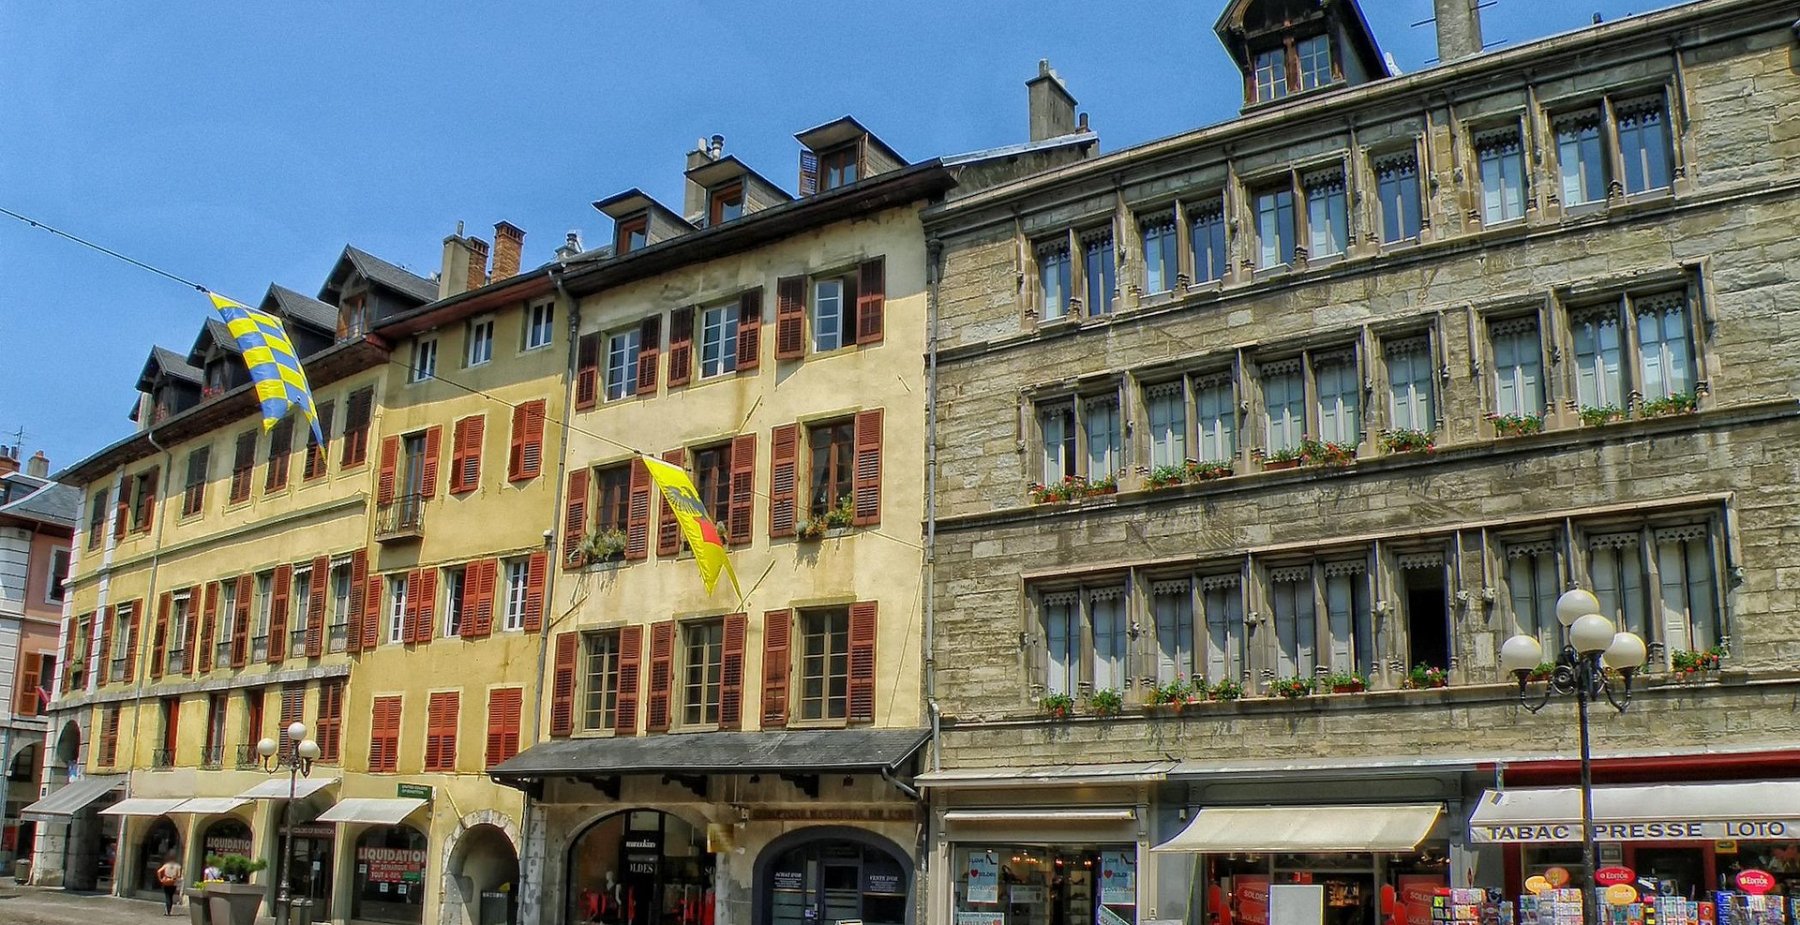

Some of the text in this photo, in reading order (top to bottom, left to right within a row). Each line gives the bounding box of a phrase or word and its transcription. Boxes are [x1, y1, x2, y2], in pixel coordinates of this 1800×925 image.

[1487, 821, 1785, 840] TABAC PRESSE LOTO
[206, 836, 251, 850] LIQUIDATIO
